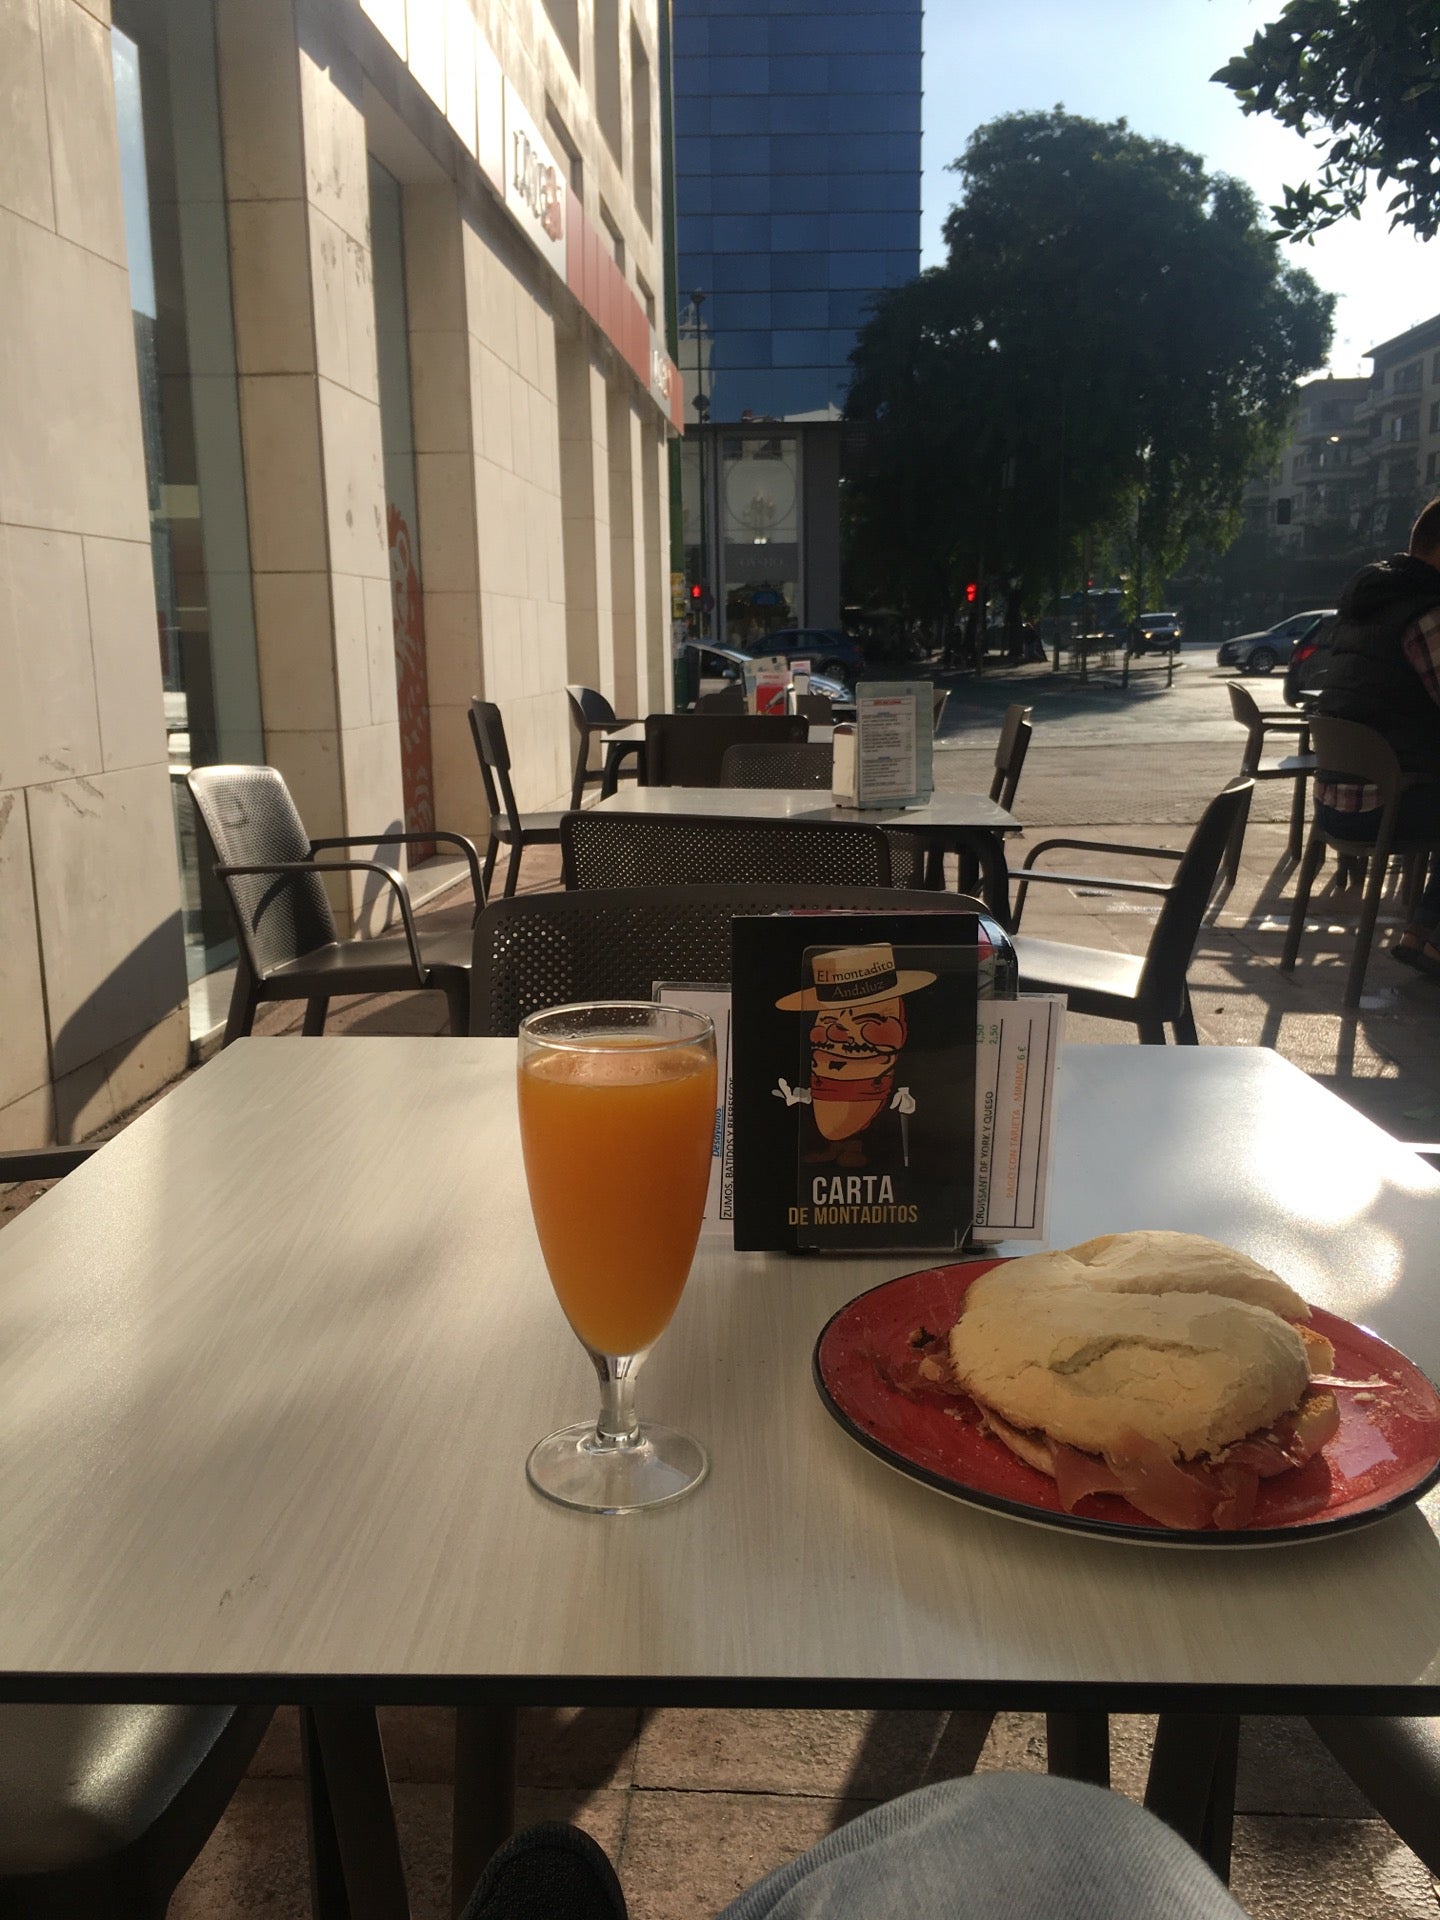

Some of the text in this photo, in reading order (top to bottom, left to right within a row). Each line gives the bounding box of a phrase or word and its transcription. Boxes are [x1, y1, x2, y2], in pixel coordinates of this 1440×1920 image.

[817, 960, 894, 982] El montadito
[832, 981, 885, 998] Andaluz
[984, 1091, 994, 1124] QUESO
[981, 1135, 990, 1158] YORK
[725, 1139, 734, 1178] BATIDOS
[980, 1161, 988, 1173] DE
[1008, 1150, 1017, 1170] CON
[724, 1181, 734, 1217] ZUMOS,
[812, 1175, 894, 1205] CARTA
[975, 1176, 988, 1224] CROISSANT
[788, 1205, 918, 1225] DE MONTADITOS
